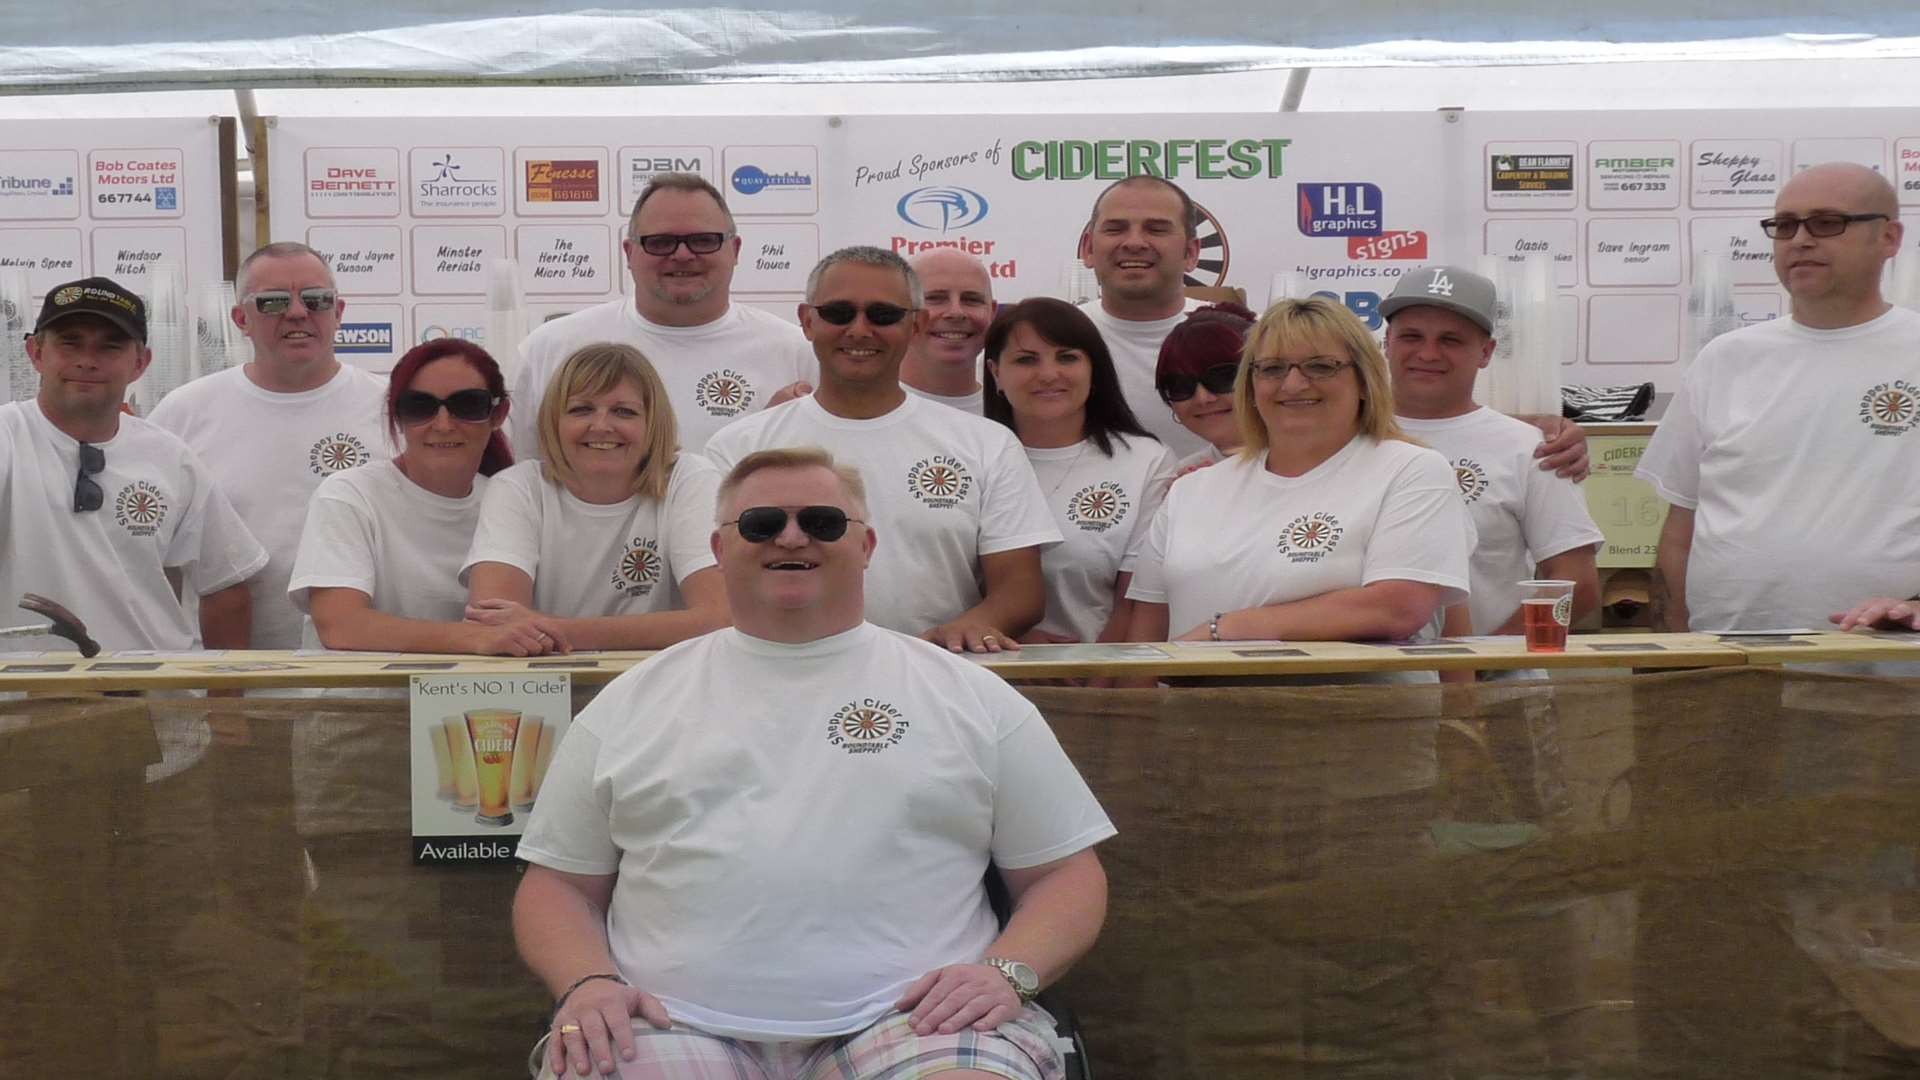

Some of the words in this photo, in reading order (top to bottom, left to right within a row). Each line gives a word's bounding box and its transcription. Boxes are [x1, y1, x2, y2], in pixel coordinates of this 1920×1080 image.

[96, 161, 123, 171] Bob
[127, 161, 177, 171] Coates
[632, 158, 700, 171] DBM
[855, 161, 901, 187] Proud
[908, 151, 979, 182] Sponsors
[985, 138, 1002, 165] of
[1012, 138, 1293, 182] CIDERFEST
[1595, 159, 1675, 169] AMBER
[1697, 152, 1760, 168] Sheppy
[531, 163, 595, 181] Finesse
[1729, 170, 1776, 187] Glass
[98, 175, 148, 185] Motors
[152, 174, 174, 184] Ltd
[420, 183, 497, 197] Sharrocks
[1621, 182, 1643, 191] 667
[1644, 182, 1666, 191] 333
[98, 194, 152, 204] 667744
[1323, 186, 1376, 216] H&L
[1312, 218, 1377, 232] graphics
[555, 239, 573, 250] The
[890, 237, 996, 256] Premier
[1355, 230, 1419, 260] signs
[1515, 239, 1549, 251] Oasis
[1598, 241, 1624, 253] Dave
[1629, 240, 1671, 255] Ingram
[1730, 236, 1748, 247] The
[118, 250, 161, 261] Windsor
[437, 246, 482, 258] Minster
[761, 244, 784, 255] Phil
[319, 252, 334, 262] uy
[340, 251, 360, 261] and
[365, 251, 395, 261] Jayne
[539, 251, 590, 264] Heritage
[0, 258, 35, 269] Melvin
[41, 257, 73, 270] Spree
[115, 263, 146, 274] Hitch
[336, 264, 373, 273] Russon
[437, 262, 481, 272] Aerials
[990, 260, 1017, 278] td
[534, 267, 567, 278] Micro
[572, 266, 596, 279] Pub
[1428, 269, 1453, 295] LA
[334, 328, 390, 343] EWSON
[1604, 447, 1646, 461] CIDERF
[908, 459, 929, 499] Sheppey
[933, 455, 966, 473] Cider
[956, 476, 973, 501] Fest
[1100, 481, 1126, 498] Cder
[1314, 511, 1339, 526] Cide
[1609, 545, 1640, 555] Blend
[419, 682, 468, 695] Kent's
[473, 682, 503, 695] NO
[509, 682, 515, 694] 1
[522, 681, 566, 695] Cider
[826, 700, 858, 746] Sheppey
[863, 698, 903, 718] Cider
[888, 720, 909, 745] Fest
[474, 739, 513, 752] CIDER
[420, 842, 510, 860] Available
